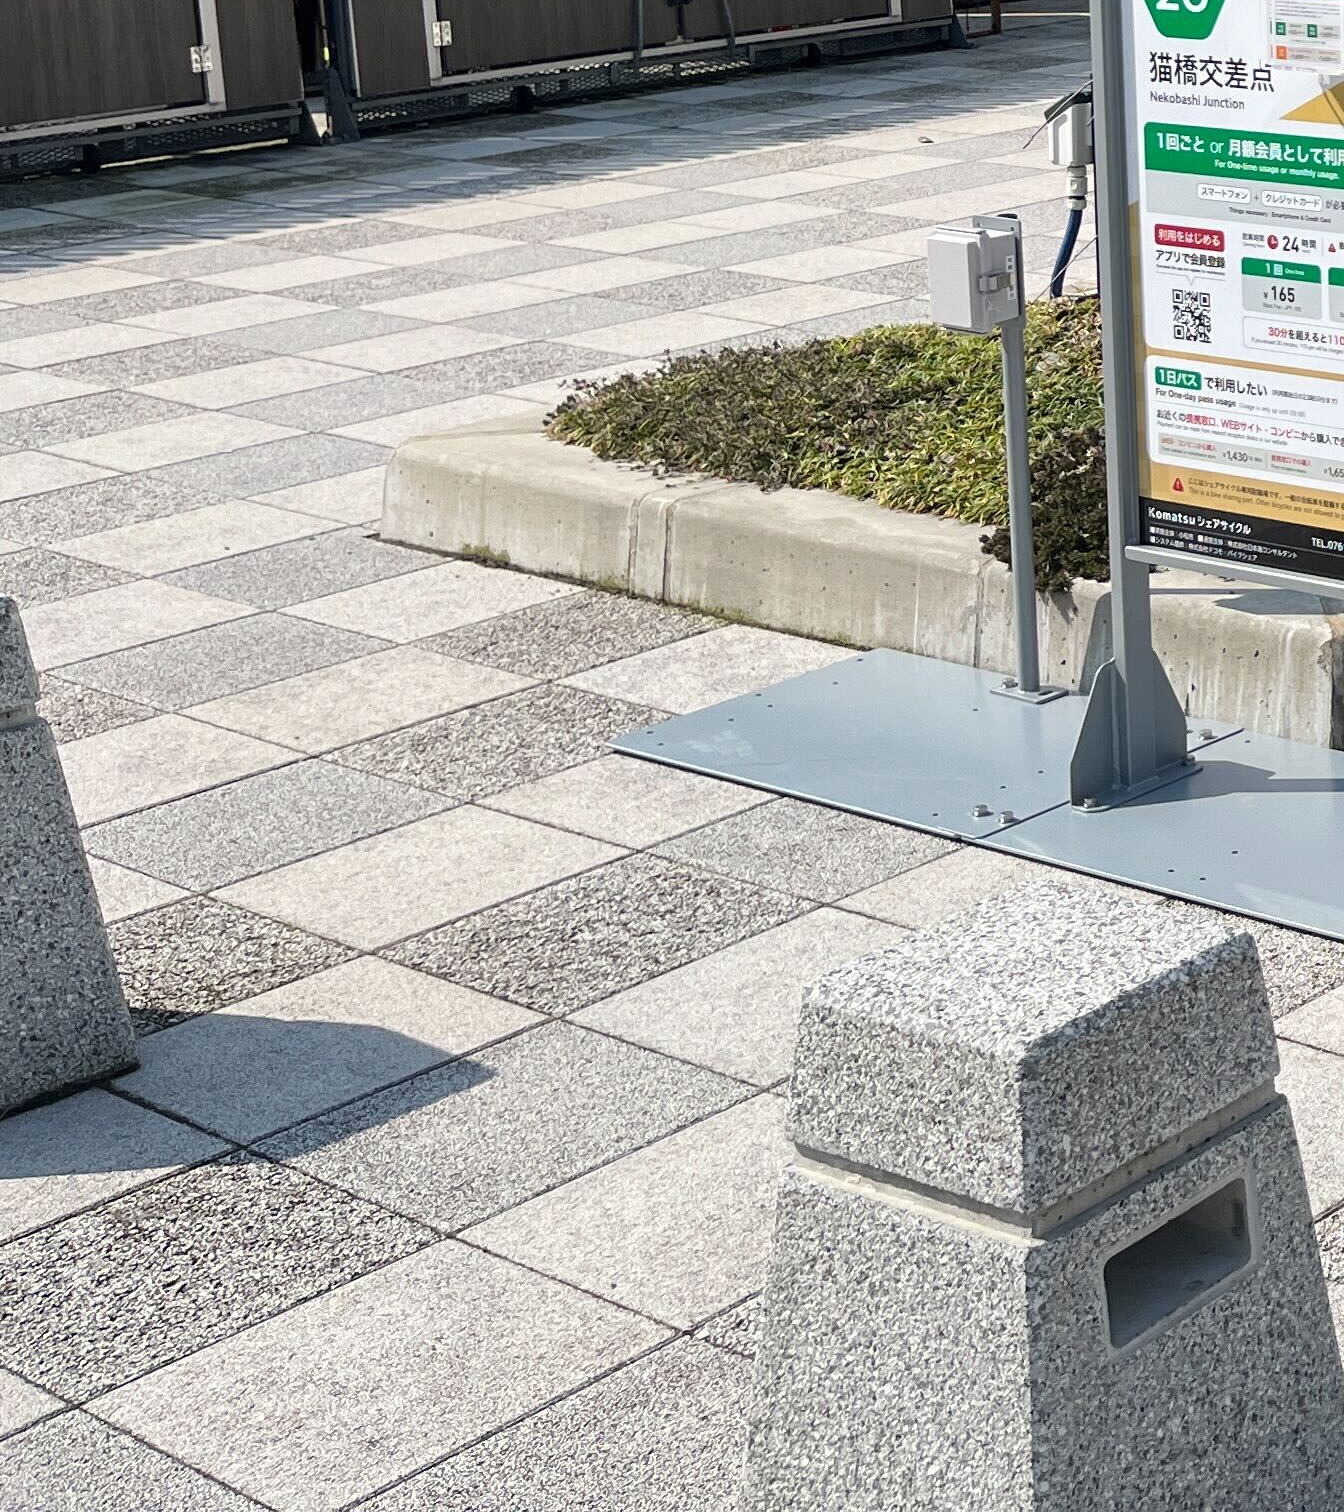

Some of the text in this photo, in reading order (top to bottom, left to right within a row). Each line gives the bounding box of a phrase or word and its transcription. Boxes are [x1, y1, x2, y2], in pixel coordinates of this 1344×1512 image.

[1149, 50, 1275, 93] 猫橋交差点
[1150, 92, 1245, 110] Nekobashi Junction
[1157, 132, 1205, 153] 1回ごと
[1210, 141, 1224, 154] or
[1215, 159, 1226, 168] For
[1259, 164, 1279, 175] usage
[1201, 186, 1248, 200] スマートフォン
[1265, 192, 1320, 207] クレジットカード
[1158, 228, 1221, 247] 利用をはじめる
[1282, 235, 1299, 252] 24
[1155, 249, 1226, 268] アプリで会員登録
[1158, 368, 1198, 388] 1日パス
[1204, 376, 1268, 397] で利用したい
[1155, 387, 1166, 396] For
[1168, 389, 1196, 402] One-day
[1148, 506, 1252, 535] Komatsu シェアサイクル
